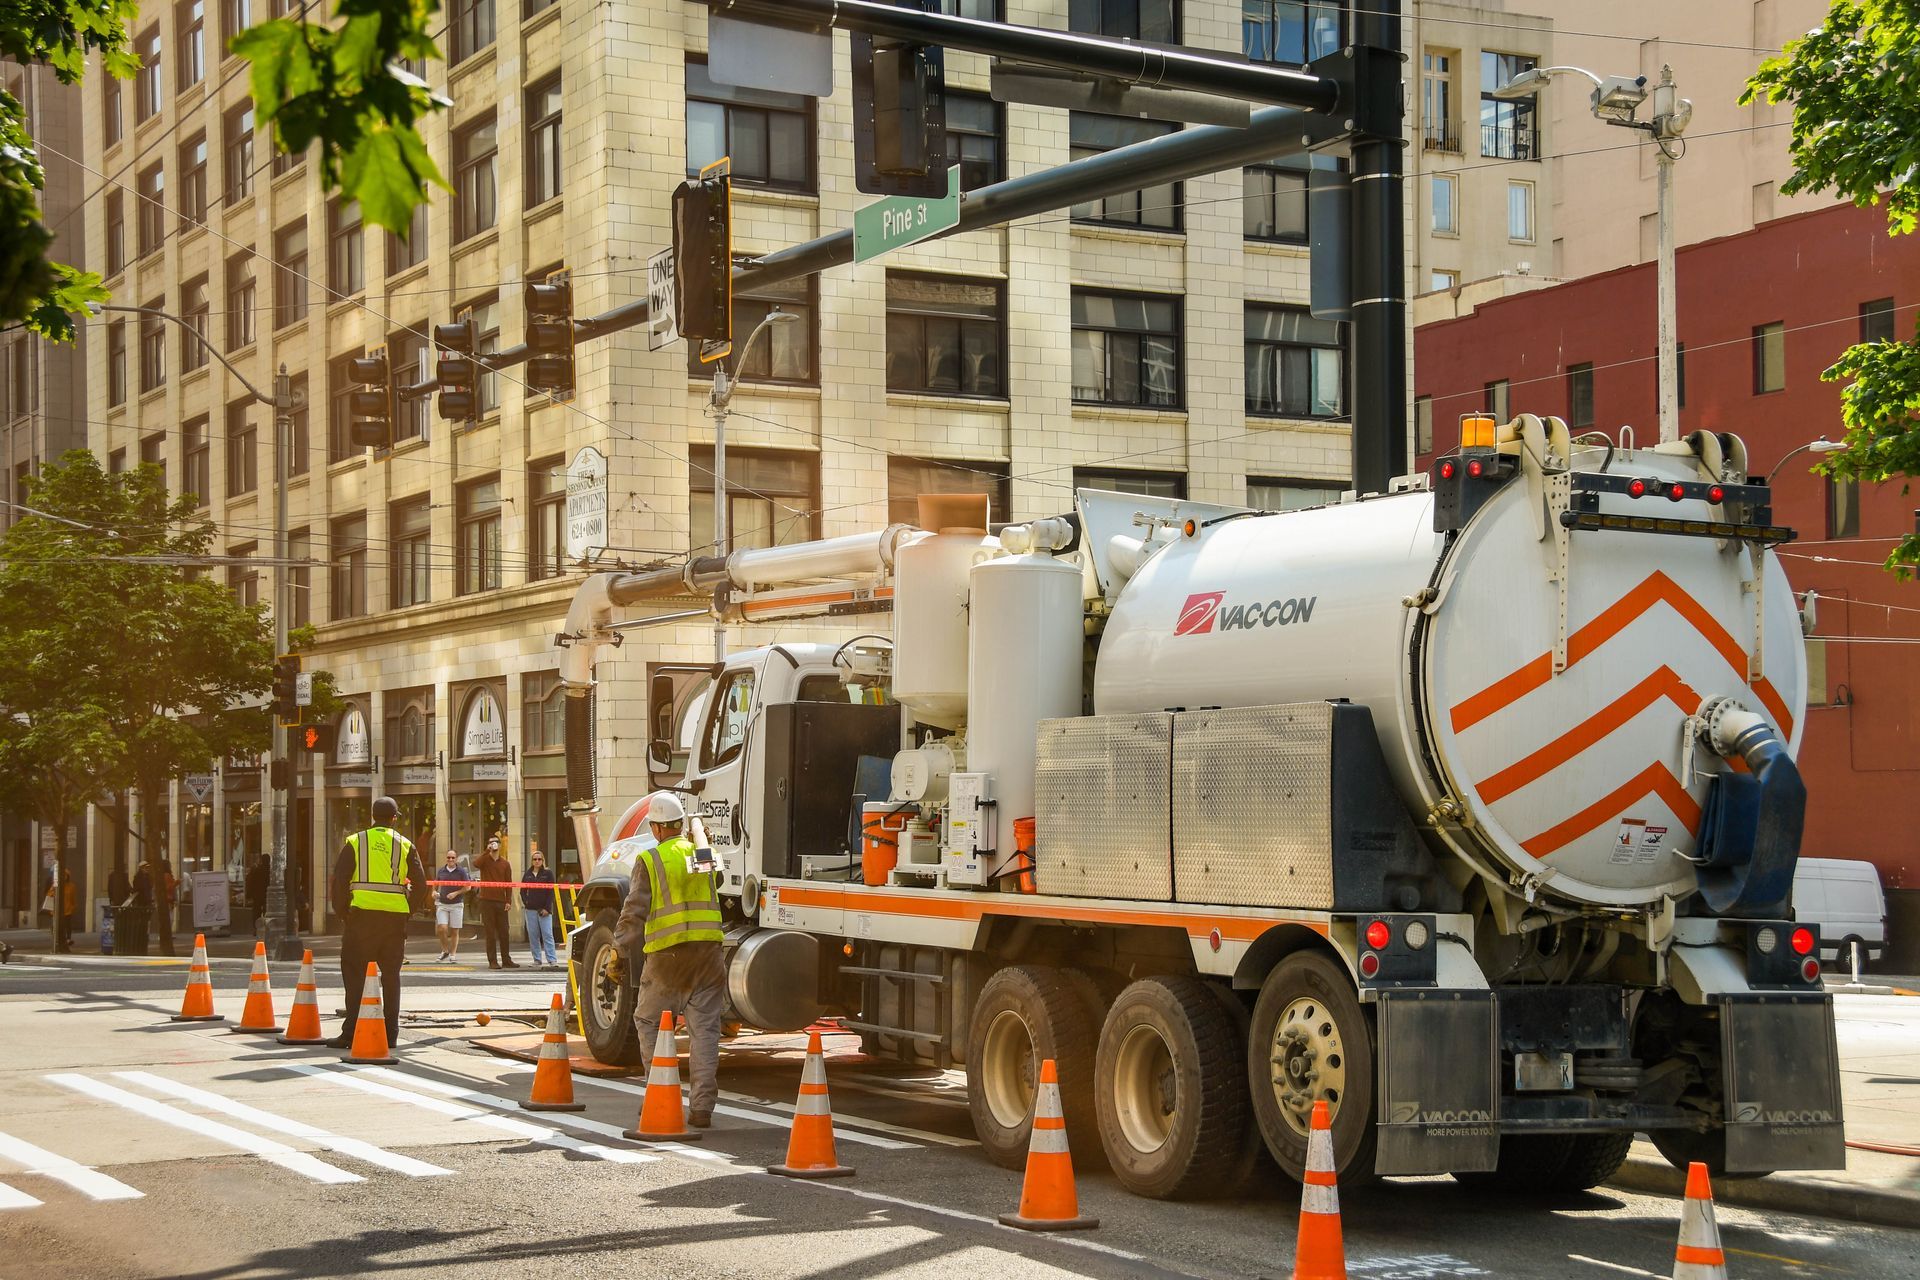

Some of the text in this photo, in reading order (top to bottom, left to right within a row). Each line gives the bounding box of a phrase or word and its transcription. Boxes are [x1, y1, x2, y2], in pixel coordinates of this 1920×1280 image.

[882, 203, 927, 240] Pine St
[652, 255, 674, 285] ONE
[652, 283, 674, 313] WAY
[568, 491, 605, 518] APARTMENTS
[341, 740, 358, 754] Simple
[468, 730, 490, 748] Simple
[1426, 1128, 1446, 1136] MORE
[1446, 1127, 1470, 1136] POWER
